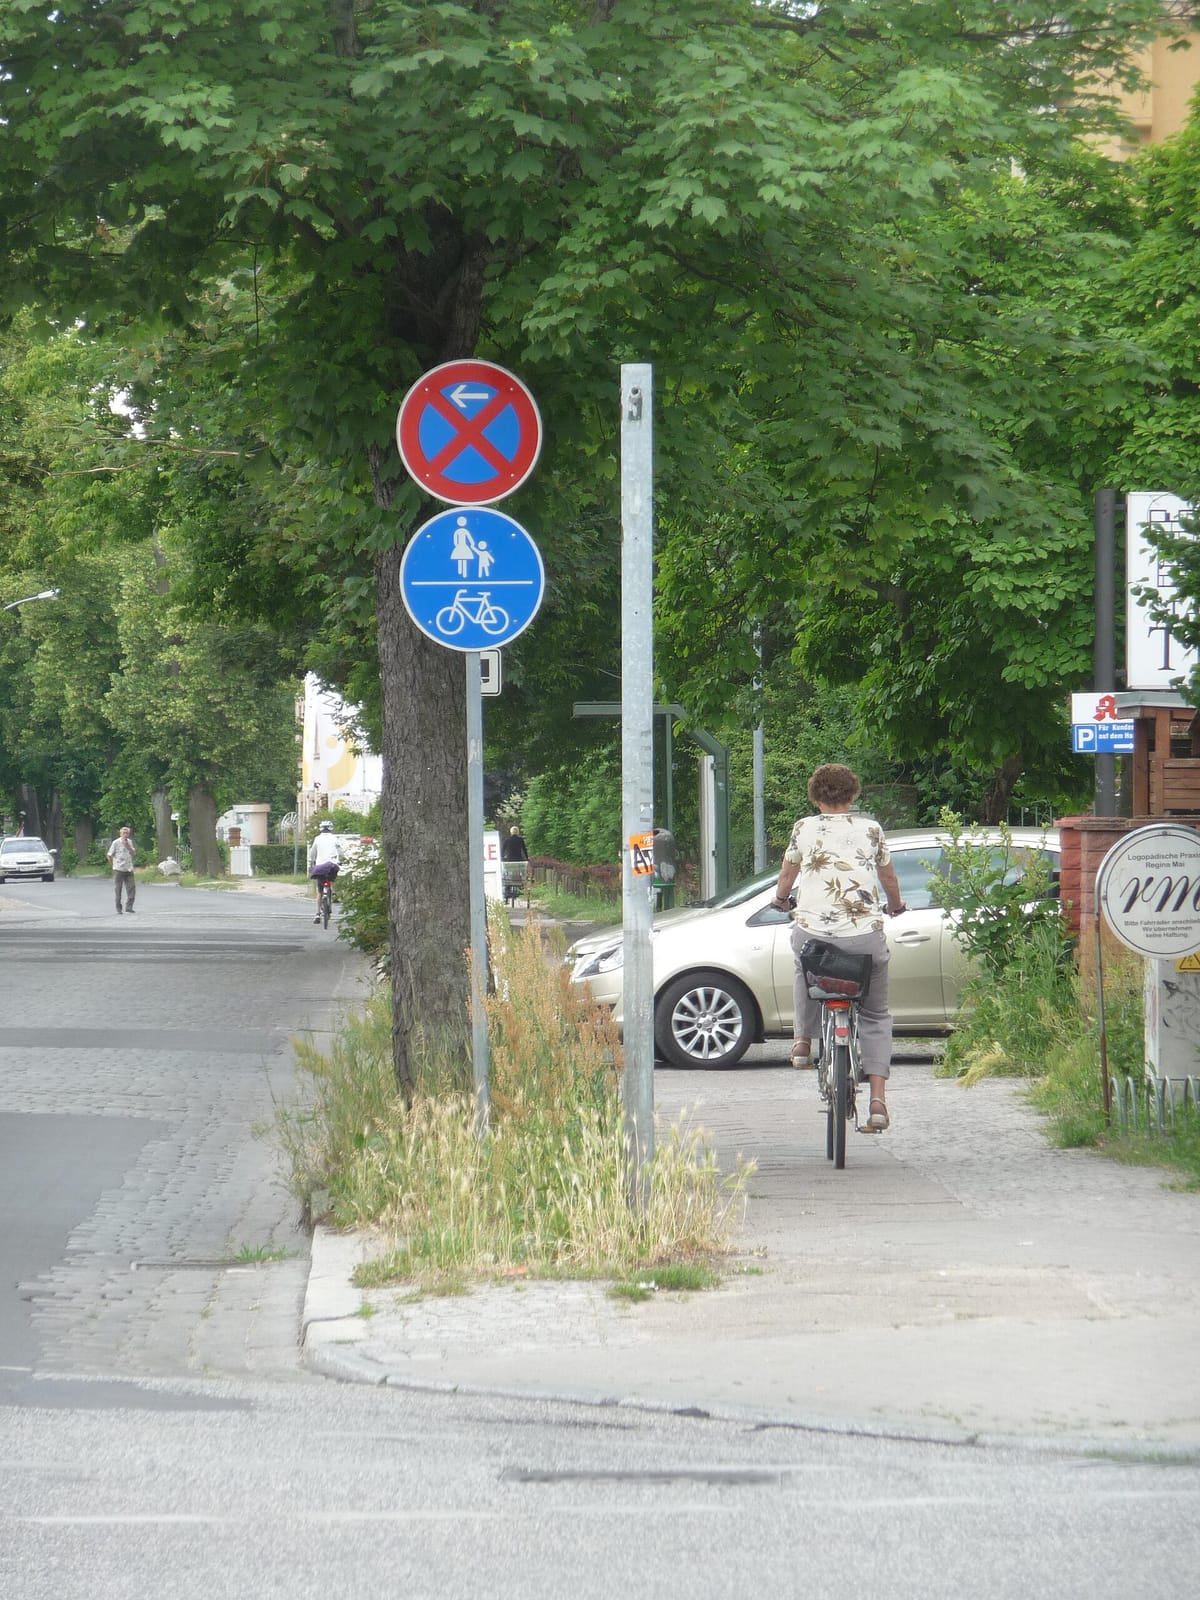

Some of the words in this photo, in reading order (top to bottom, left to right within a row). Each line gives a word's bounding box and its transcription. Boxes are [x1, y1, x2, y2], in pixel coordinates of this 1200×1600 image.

[1078, 728, 1094, 749] P
[1110, 732, 1124, 740] dem
[1127, 853, 1178, 861] Logopädische
[1145, 861, 1171, 869] Regina
